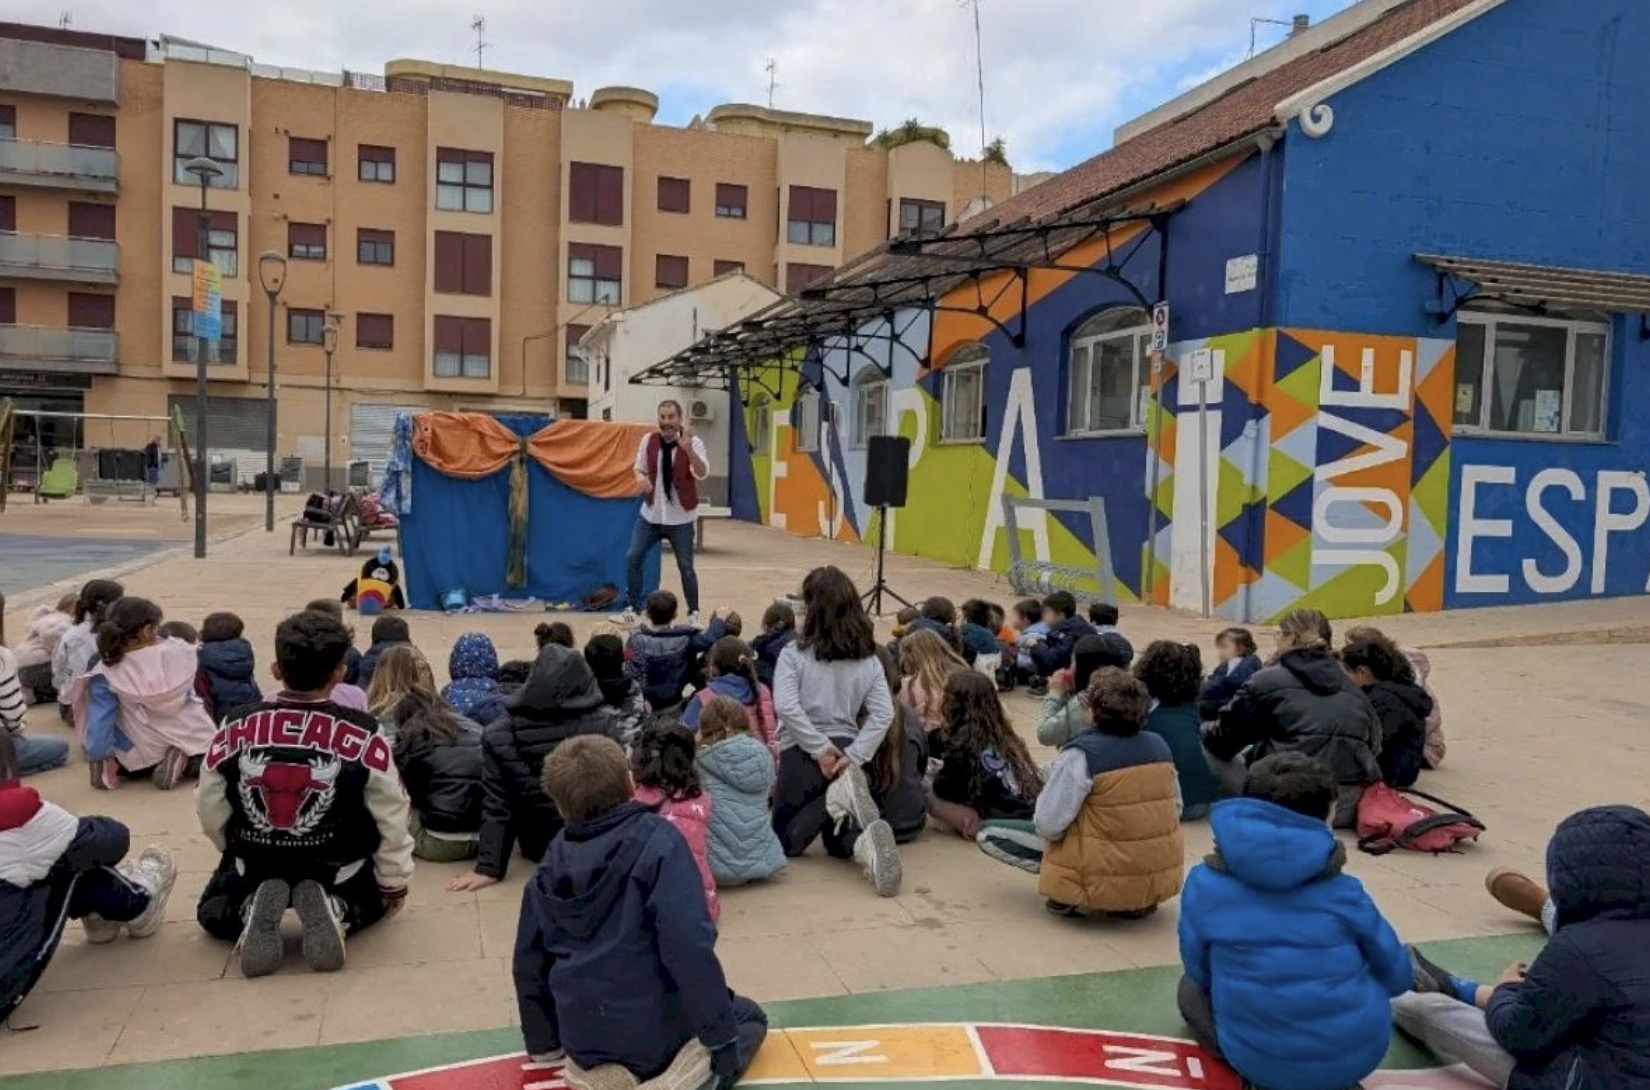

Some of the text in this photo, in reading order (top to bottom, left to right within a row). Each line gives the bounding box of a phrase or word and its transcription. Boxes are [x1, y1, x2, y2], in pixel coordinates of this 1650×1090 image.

[1312, 344, 1413, 606] JOVE
[1455, 464, 1650, 594] ESP
[205, 708, 392, 773] CHICAGO
